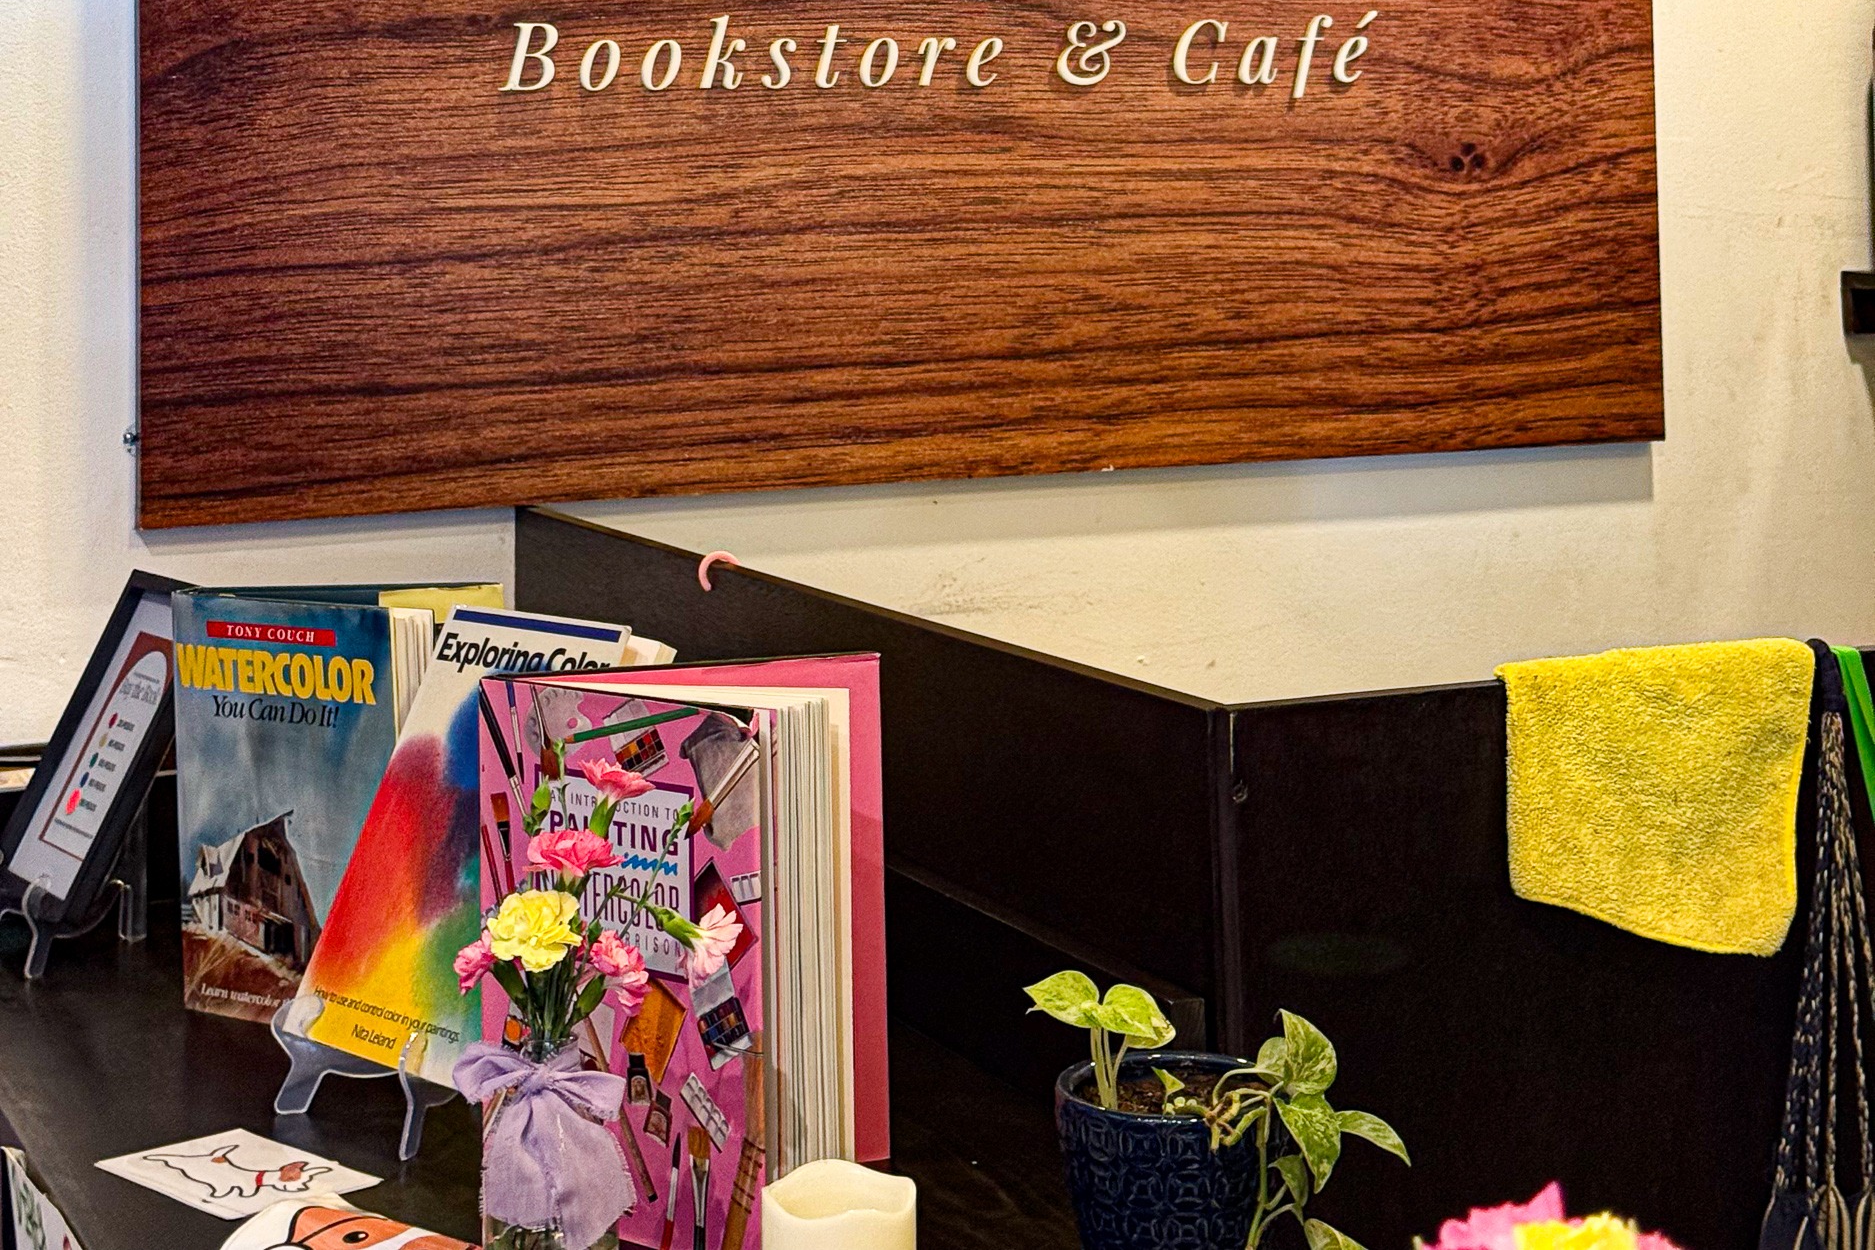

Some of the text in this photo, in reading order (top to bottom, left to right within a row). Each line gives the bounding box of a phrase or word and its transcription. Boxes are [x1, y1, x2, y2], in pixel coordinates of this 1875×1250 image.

[498, 10, 1378, 98] Bookstore & Café
[226, 625, 315, 643] TONY COUCH
[436, 632, 545, 673] Exploring
[176, 642, 376, 706] WATERCOLOR
[212, 695, 340, 729] You Can Do It!
[550, 789, 679, 821] A INTRUCTION TO
[550, 810, 679, 856] PAITING
[543, 868, 680, 931] ERCOLOR
[605, 928, 682, 958] RRISON
[201, 983, 228, 999] Learn
[337, 995, 348, 1007] use
[347, 998, 362, 1011] and
[361, 1002, 385, 1018] control
[383, 1008, 402, 1023] color
[400, 1013, 410, 1026] in
[352, 1023, 369, 1041] Nita
